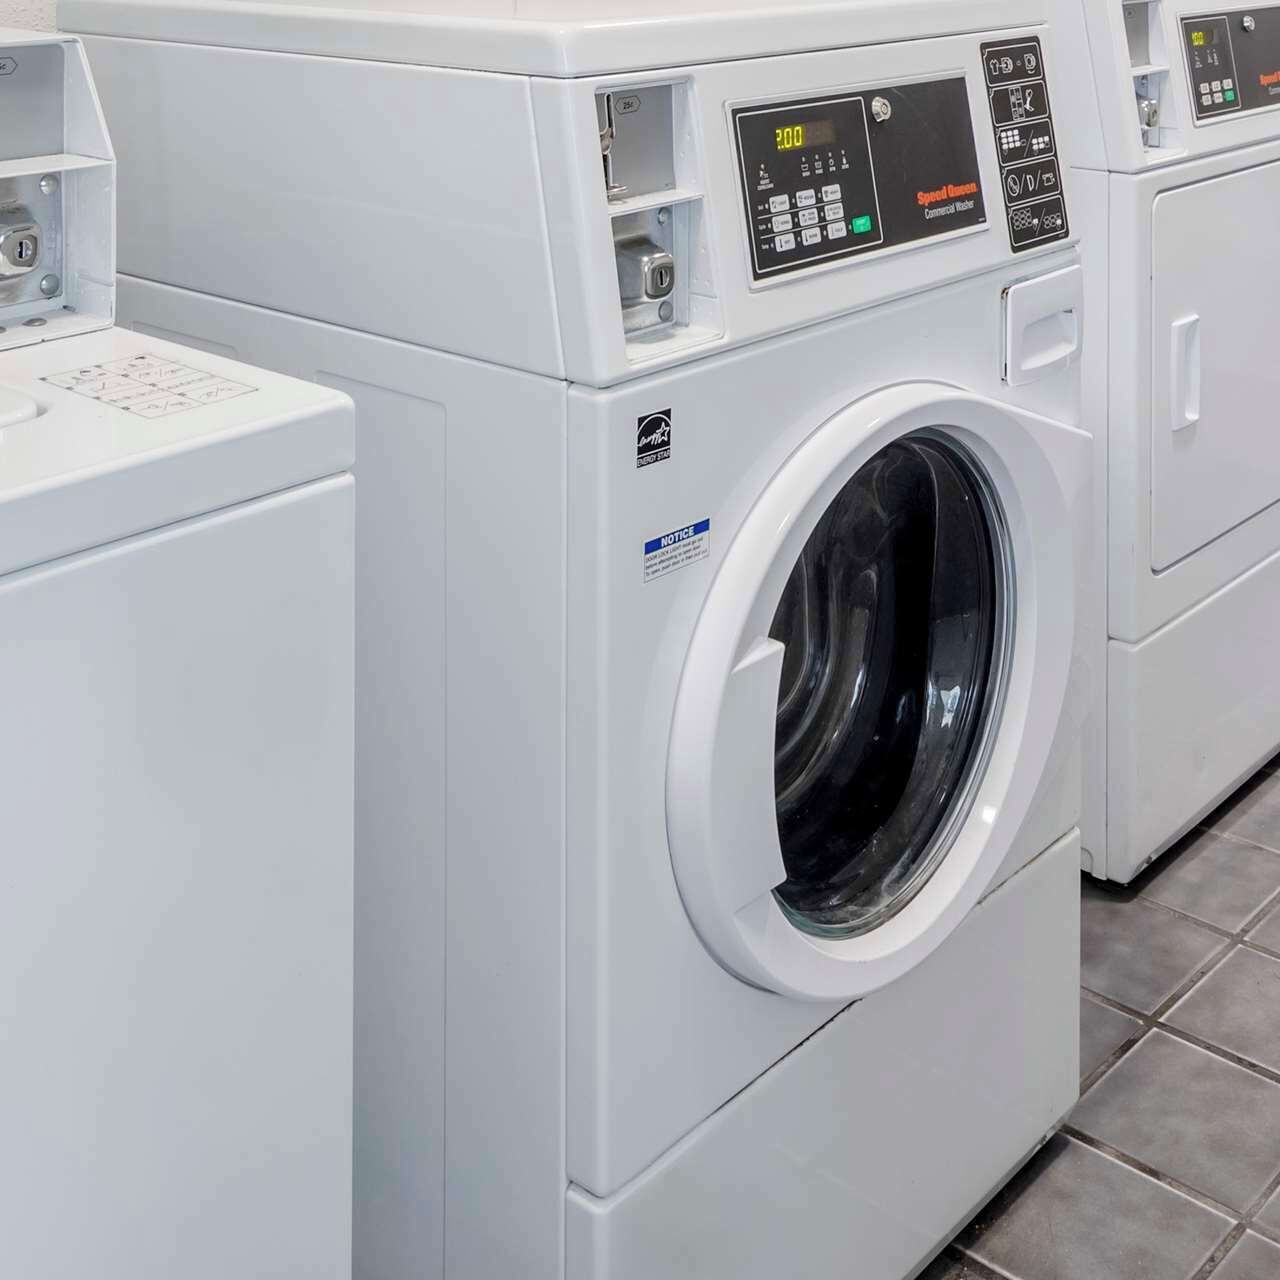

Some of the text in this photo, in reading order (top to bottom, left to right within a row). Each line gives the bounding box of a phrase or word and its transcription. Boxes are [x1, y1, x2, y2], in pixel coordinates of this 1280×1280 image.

[917, 182, 978, 206] Speed Queen
[924, 203, 956, 220] Commercial
[661, 526, 695, 548] NOTICE
